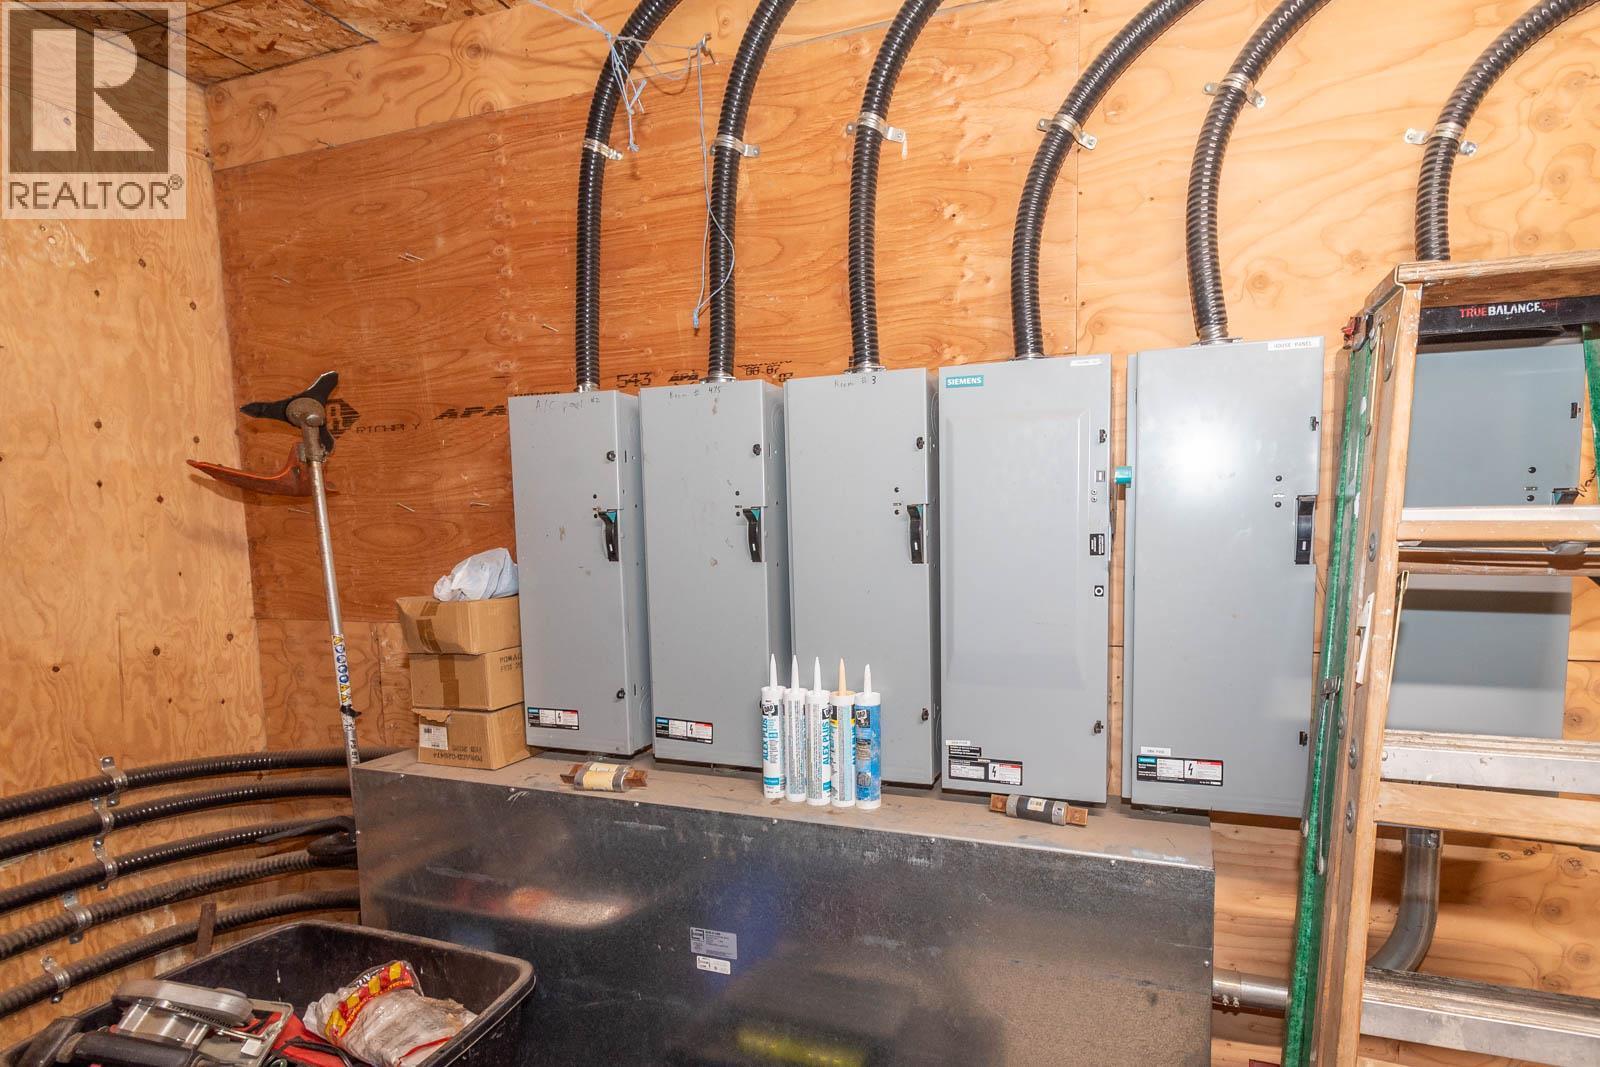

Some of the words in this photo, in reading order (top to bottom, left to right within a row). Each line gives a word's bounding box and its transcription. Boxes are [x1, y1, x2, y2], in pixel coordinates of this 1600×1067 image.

[616, 372, 653, 389] 543
[871, 376, 877, 385] 3
[947, 377, 981, 387] SIEMENS
